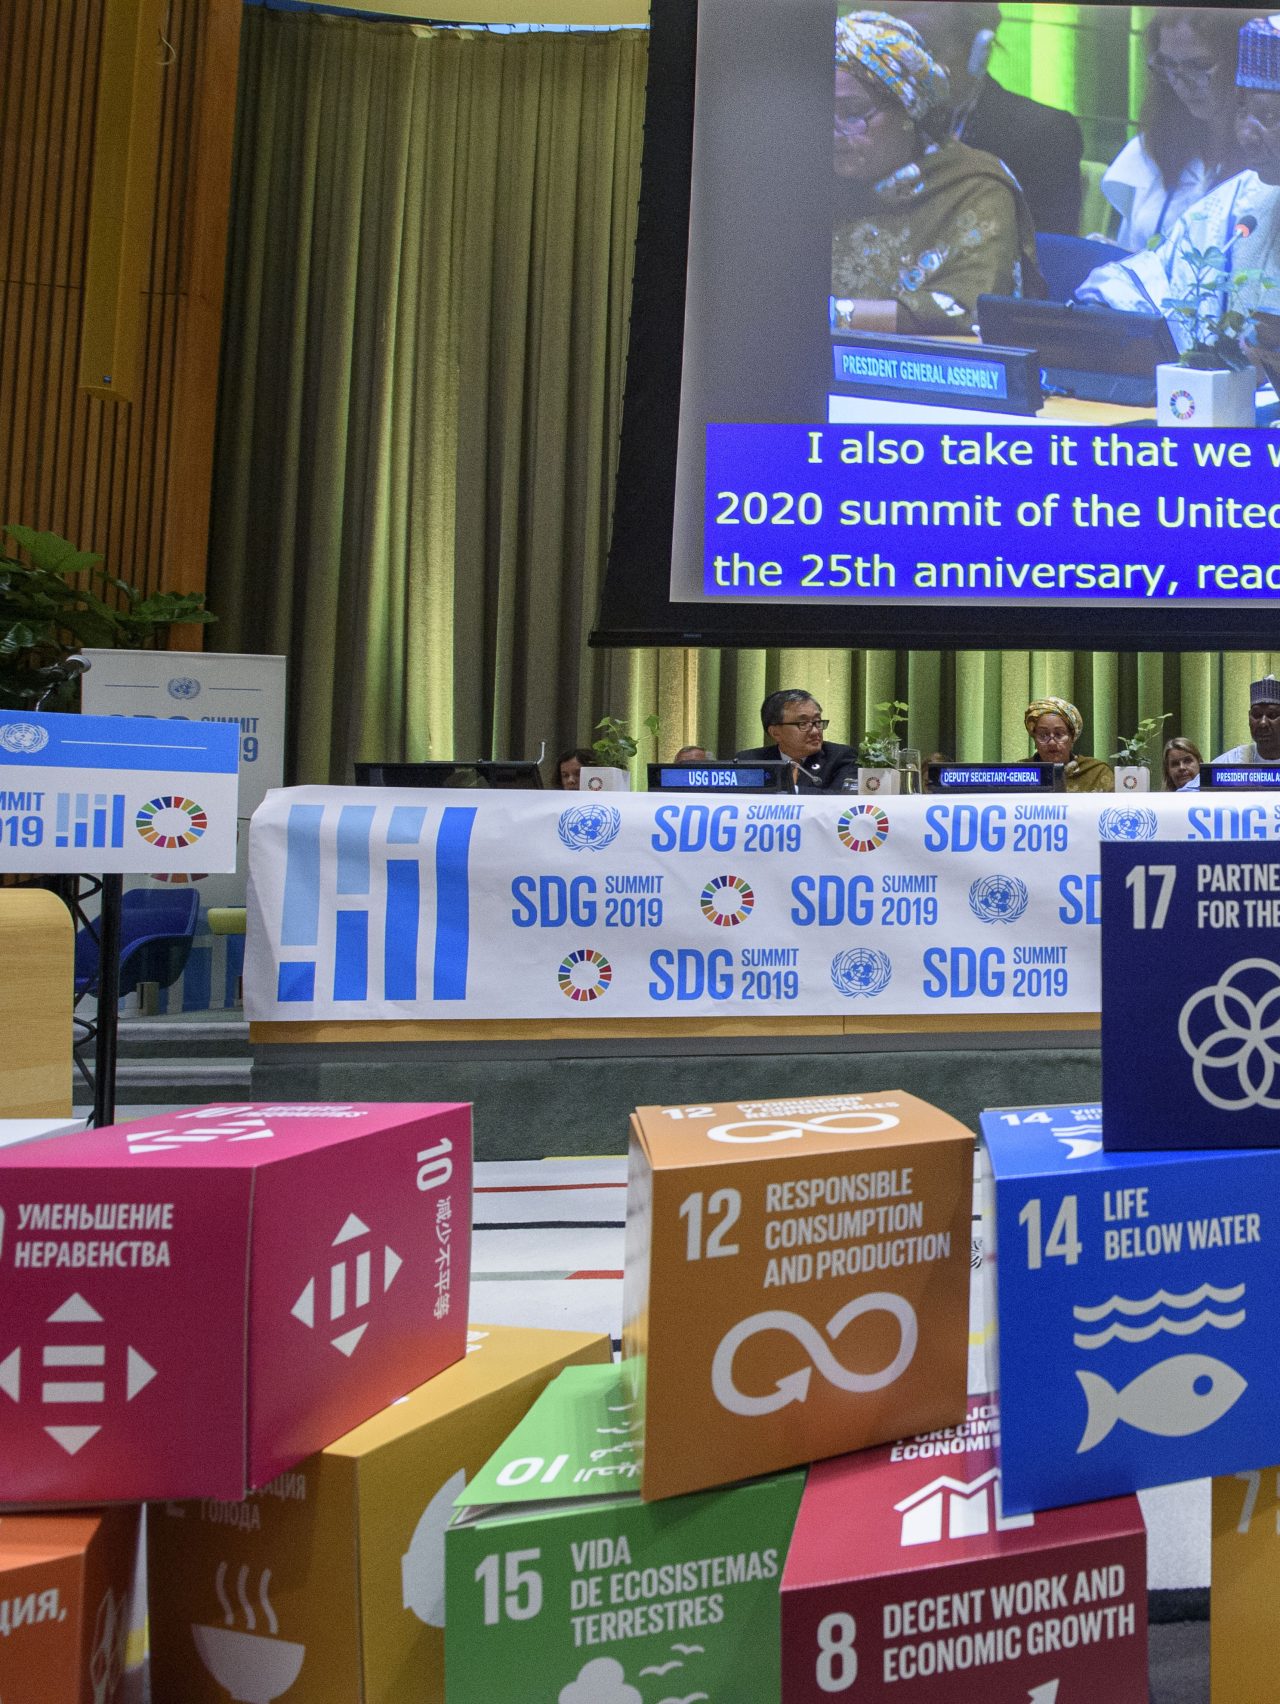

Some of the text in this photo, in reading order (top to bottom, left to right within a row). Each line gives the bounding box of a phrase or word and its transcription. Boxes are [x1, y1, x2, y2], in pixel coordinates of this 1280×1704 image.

[843, 355, 998, 390] PRESIDENT GENERAL ASSEMBLY
[808, 432, 822, 464] I
[840, 433, 925, 466] also
[941, 434, 1033, 466] take
[1050, 434, 1077, 467] it
[1093, 434, 1178, 467] that
[1194, 444, 1251, 468] we
[715, 492, 822, 526] 2020
[840, 494, 1001, 527] summit
[1017, 494, 1058, 527] of
[1073, 495, 1140, 528] the
[713, 554, 783, 587] the
[801, 554, 896, 588] 25th
[914, 557, 1178, 596] anniversary,
[688, 771, 738, 786] USG DESA
[944, 772, 1038, 783] DEPUTY SECRETARY-GENERAL
[1216, 772, 1248, 782] PRESIDENT
[1249, 772, 1274, 782] GENERAL
[651, 805, 738, 852] SDG
[747, 805, 804, 820] SUMMIT
[924, 805, 1006, 852] SDG
[1014, 805, 1067, 820] SUMMIT
[1188, 805, 1266, 839] SDG
[0, 816, 44, 847] 19
[744, 824, 801, 853] 2019
[1013, 824, 1067, 852] 2019
[512, 875, 596, 928] SDG
[605, 875, 664, 894] SUMMIT
[791, 875, 874, 926] SDG
[882, 875, 938, 892] SUMMIT
[1059, 874, 1102, 925] SD
[1126, 865, 1177, 929] 17
[605, 898, 663, 928] 2019
[881, 897, 937, 926] 2019
[1198, 900, 1240, 929] FOR
[742, 948, 799, 966] SUMMIT
[923, 946, 1005, 997] SDG
[1013, 946, 1067, 964] SUMMIT
[649, 949, 734, 1001] SDG
[742, 971, 799, 1000] 2019
[1013, 968, 1067, 997] 2019
[662, 1106, 717, 1120] 12
[1000, 1112, 1053, 1126] 14
[417, 1138, 452, 1191] 10
[766, 1168, 913, 1213] RESPONSIBLE
[1104, 1187, 1149, 1222] LIFE
[17, 1204, 174, 1231] УМЕНЬШЕНИЕ
[679, 1188, 742, 1261] 12
[765, 1201, 922, 1250] CONSUMPTION
[1018, 1195, 1082, 1270] 14
[15, 1241, 171, 1268] НЕРАВЕНСТВА
[1104, 1213, 1261, 1261] BELOW WATER
[434, 1195, 451, 1320] 减少不平等
[764, 1232, 950, 1288] AND PRODUCTION
[1234, 1470, 1260, 1534] 7
[570, 1536, 632, 1573] VIDA
[474, 1548, 543, 1626] 15
[570, 1548, 778, 1611] DE ECOSISTEMAS
[883, 1564, 1125, 1640] DECENT WORK AND
[571, 1594, 724, 1647] TERRESTRES
[815, 1612, 858, 1693] 8
[883, 1603, 1135, 1683] ECONOMIC GROWTH
